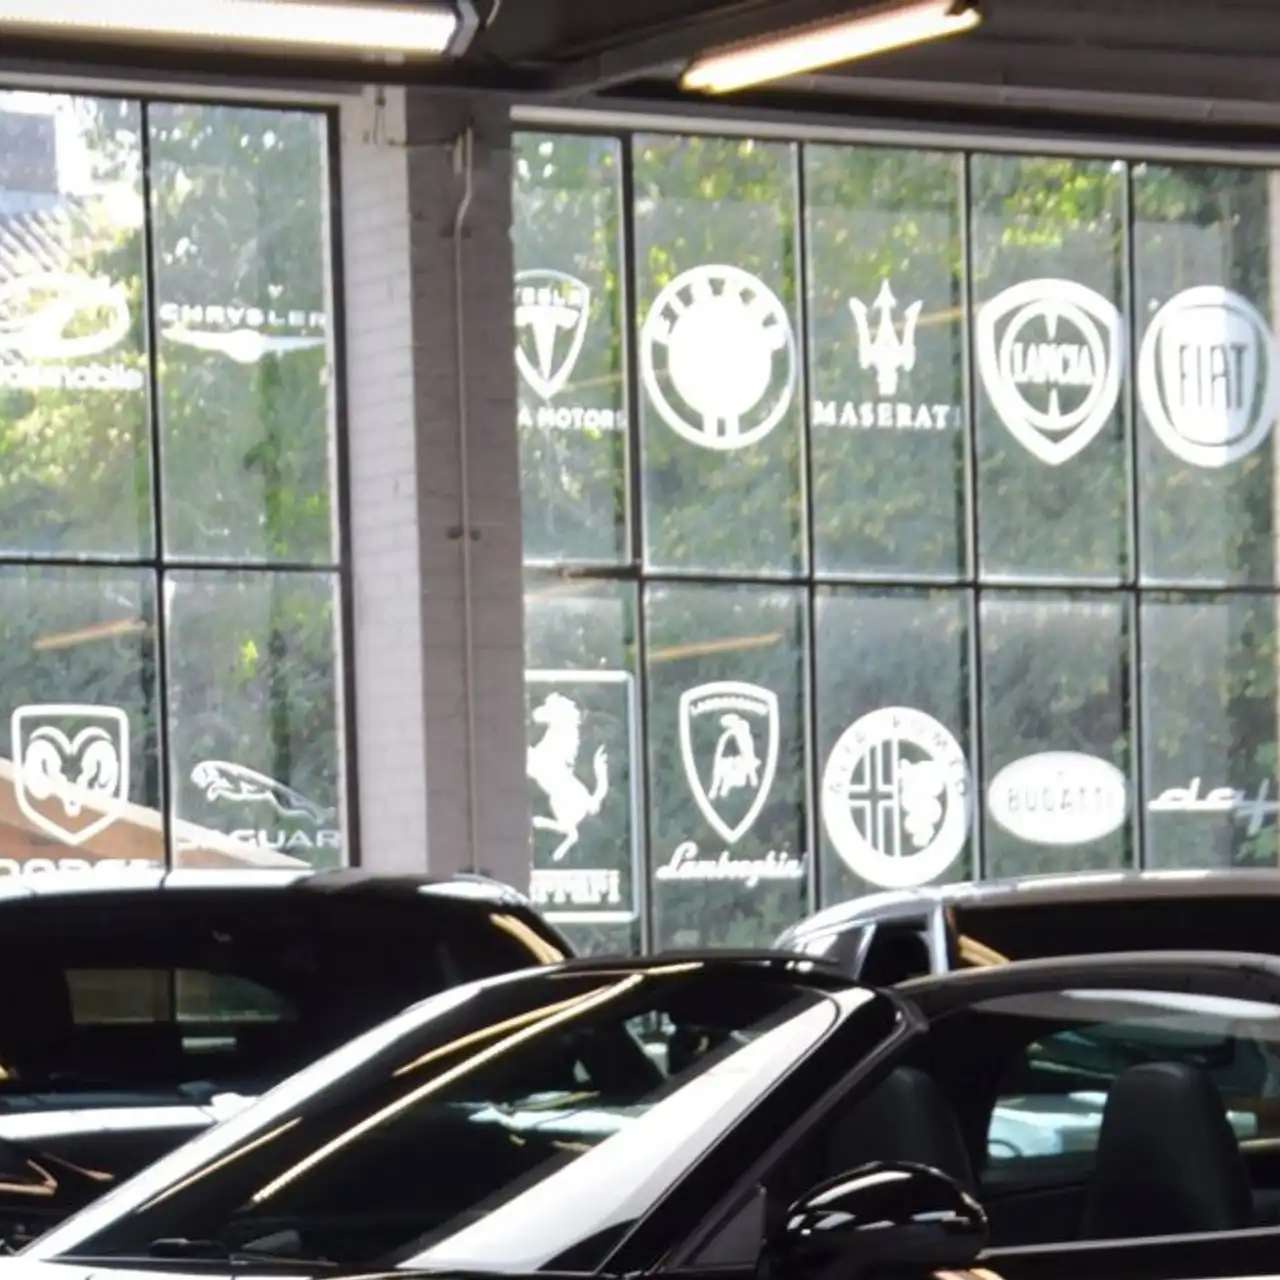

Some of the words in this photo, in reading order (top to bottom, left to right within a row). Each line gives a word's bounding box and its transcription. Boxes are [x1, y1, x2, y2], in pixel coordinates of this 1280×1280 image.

[1013, 342, 1097, 384] LANCIA
[1179, 342, 1250, 410] FIAT
[812, 400, 962, 431] MASERATI
